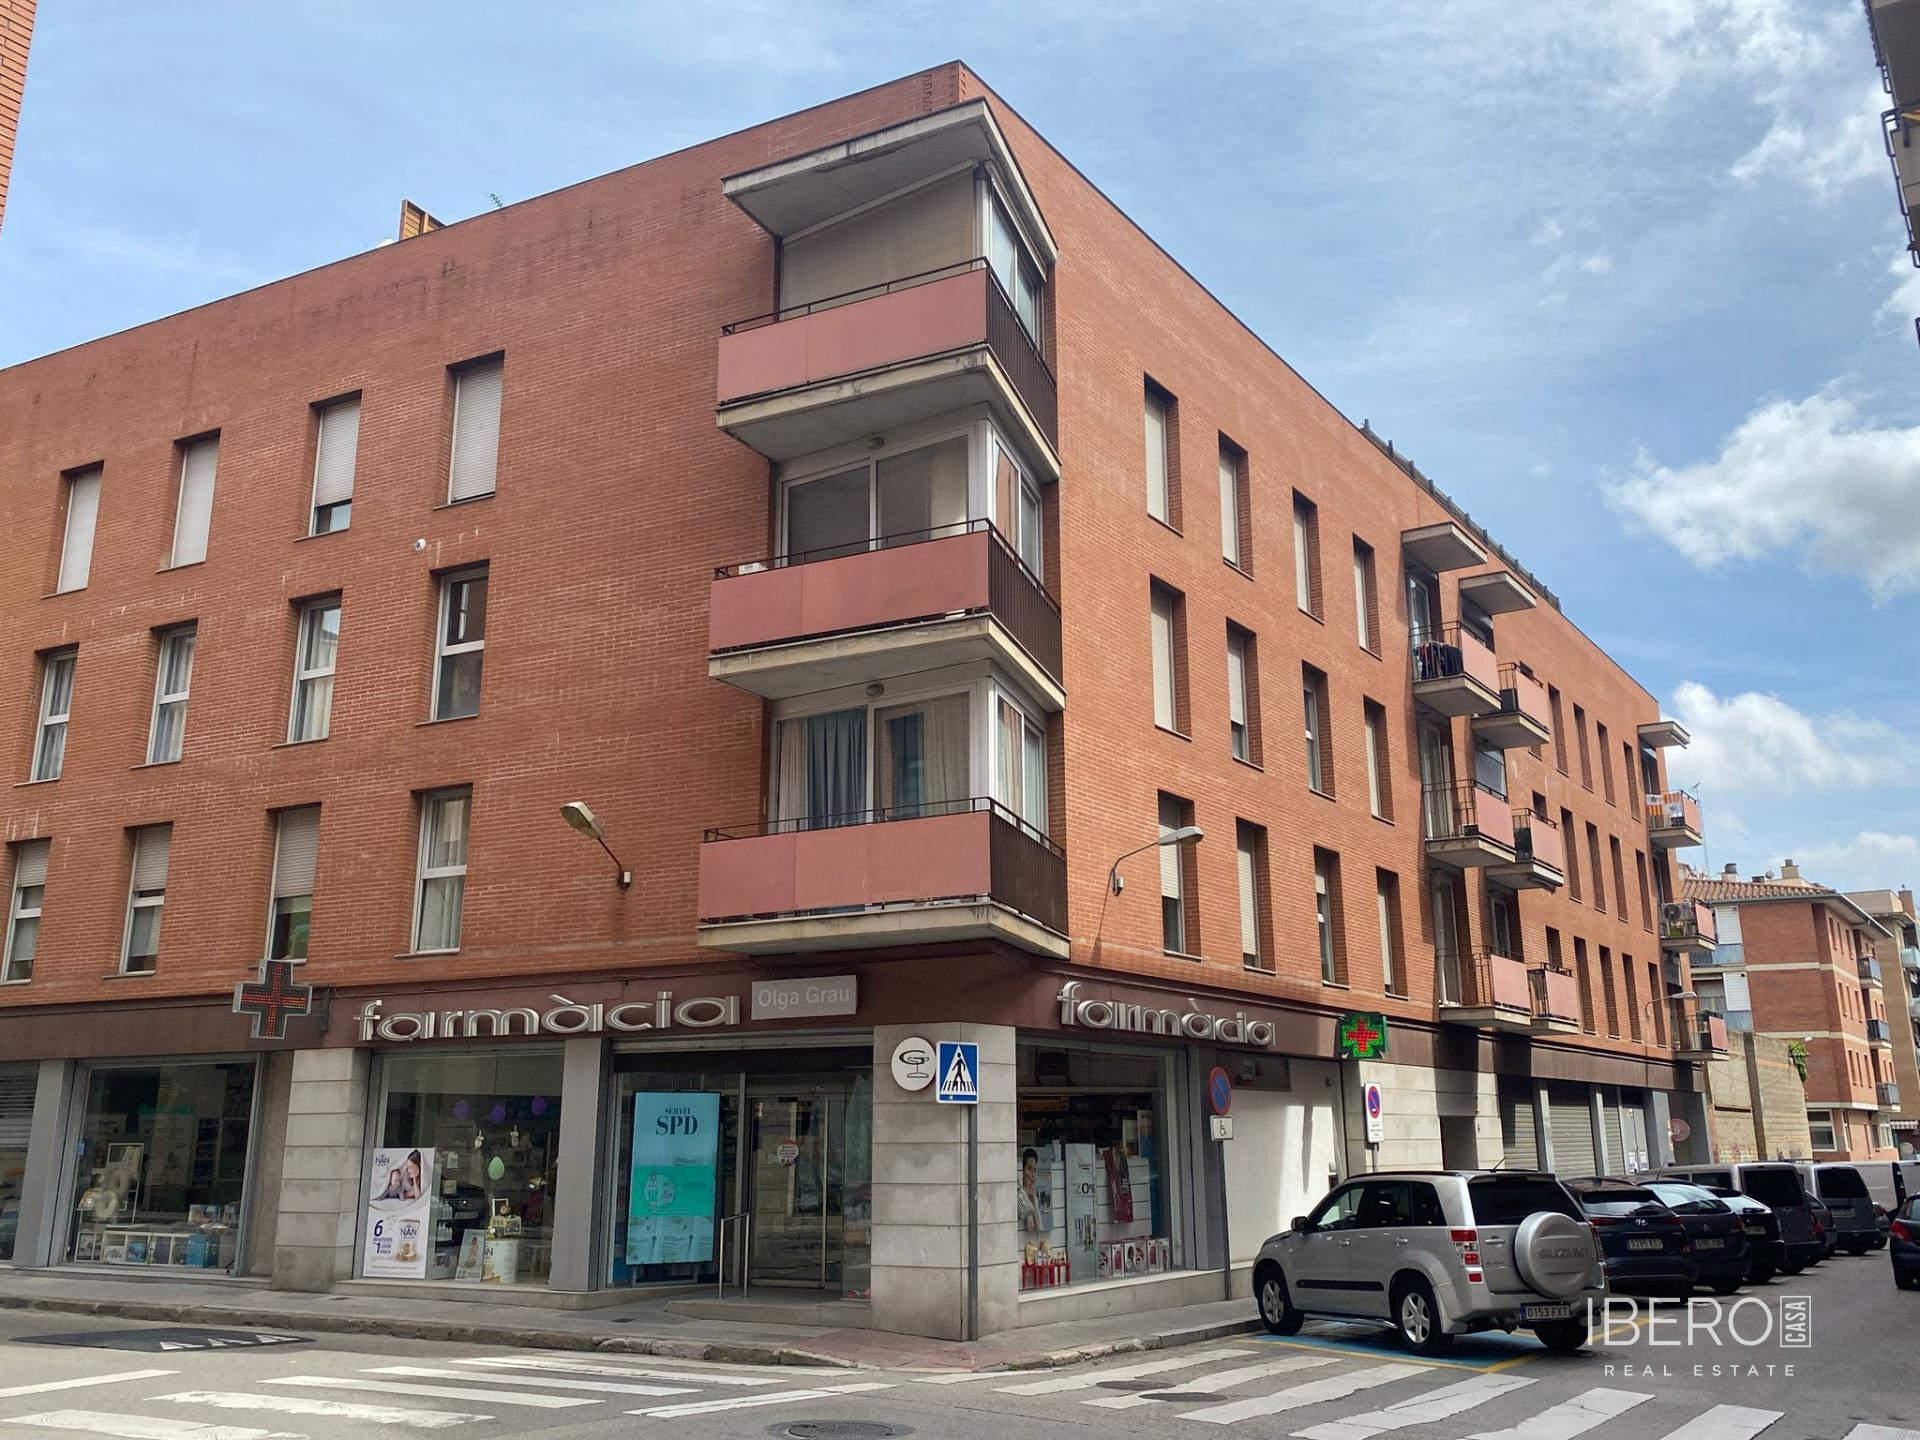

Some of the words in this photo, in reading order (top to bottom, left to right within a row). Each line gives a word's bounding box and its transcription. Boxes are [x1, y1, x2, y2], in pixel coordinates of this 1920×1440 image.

[758, 988, 799, 1010] Olga
[805, 985, 850, 1004] Grau
[354, 991, 741, 1041] farmàcia
[1057, 981, 1275, 1046] farmàcia
[664, 1106, 691, 1115] SERVEI
[655, 1115, 699, 1135] SPD
[374, 1219, 384, 1237] 6
[400, 1227, 417, 1236] NAN
[376, 1242, 381, 1254] 1
[1527, 1305, 1550, 1317] 0153
[1551, 1304, 1568, 1316] FXT
